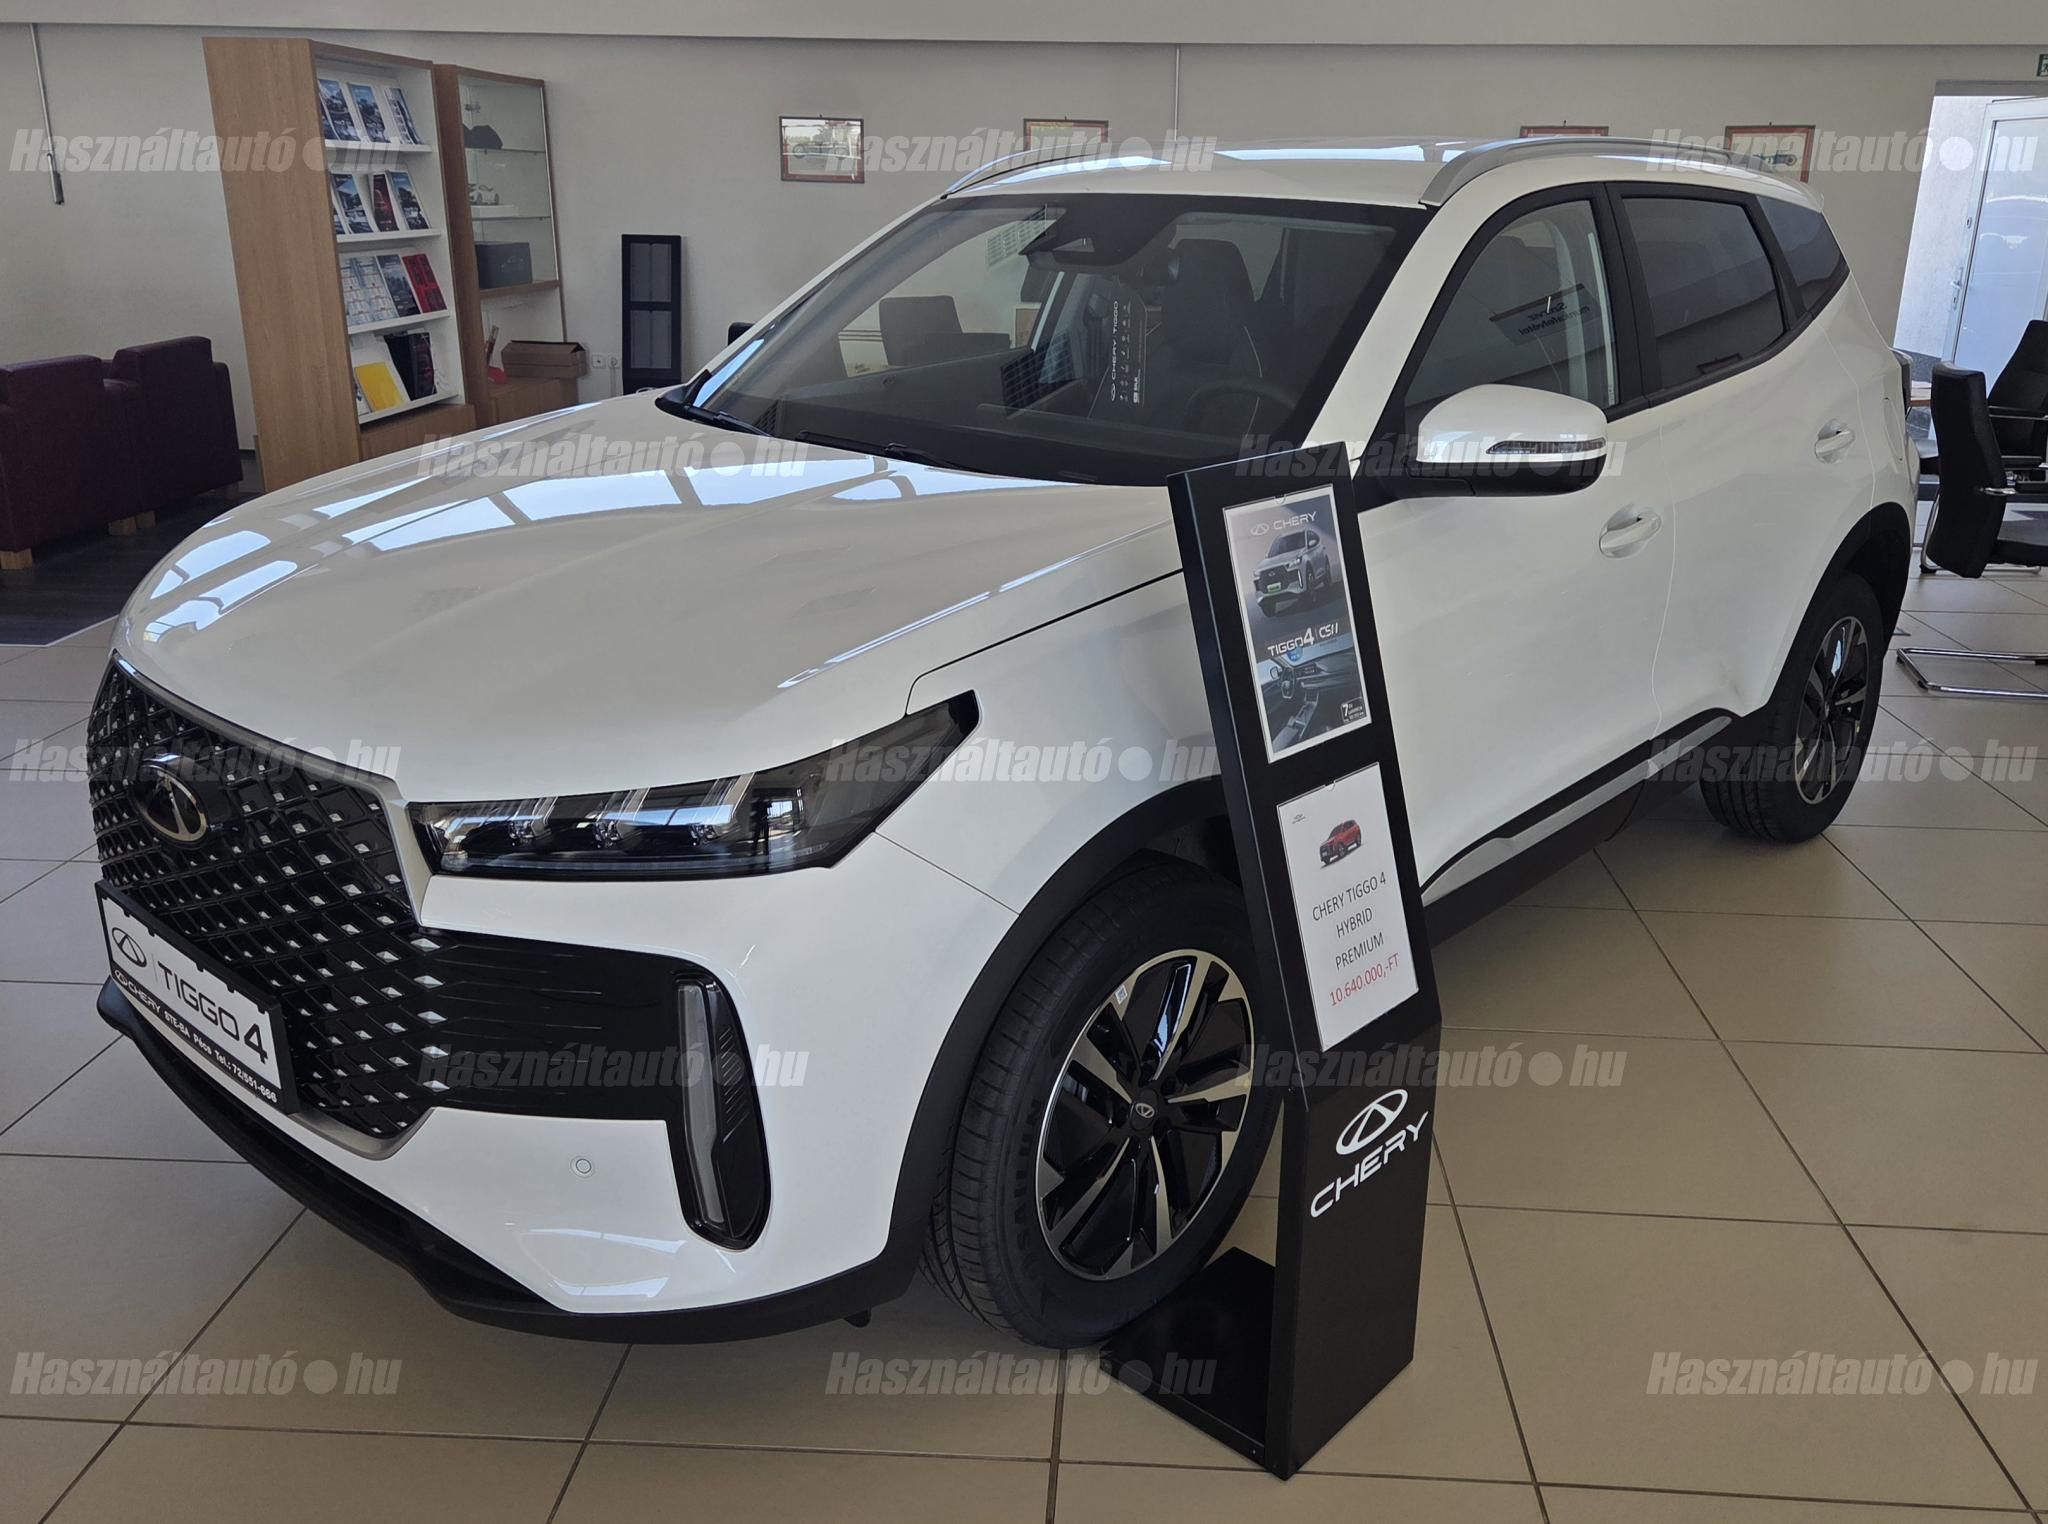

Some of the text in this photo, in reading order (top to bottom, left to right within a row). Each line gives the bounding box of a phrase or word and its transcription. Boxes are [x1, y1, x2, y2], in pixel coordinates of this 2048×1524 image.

[1273, 511, 1317, 530] CHERY
[1312, 871, 1387, 922] CHERY TIGGO 4
[1335, 907, 1374, 939] HYBRID
[1335, 932, 1385, 971] PREMIUM
[1329, 953, 1400, 1007] 10.640.000,-FT
[1310, 1110, 1429, 1218] CHERY
